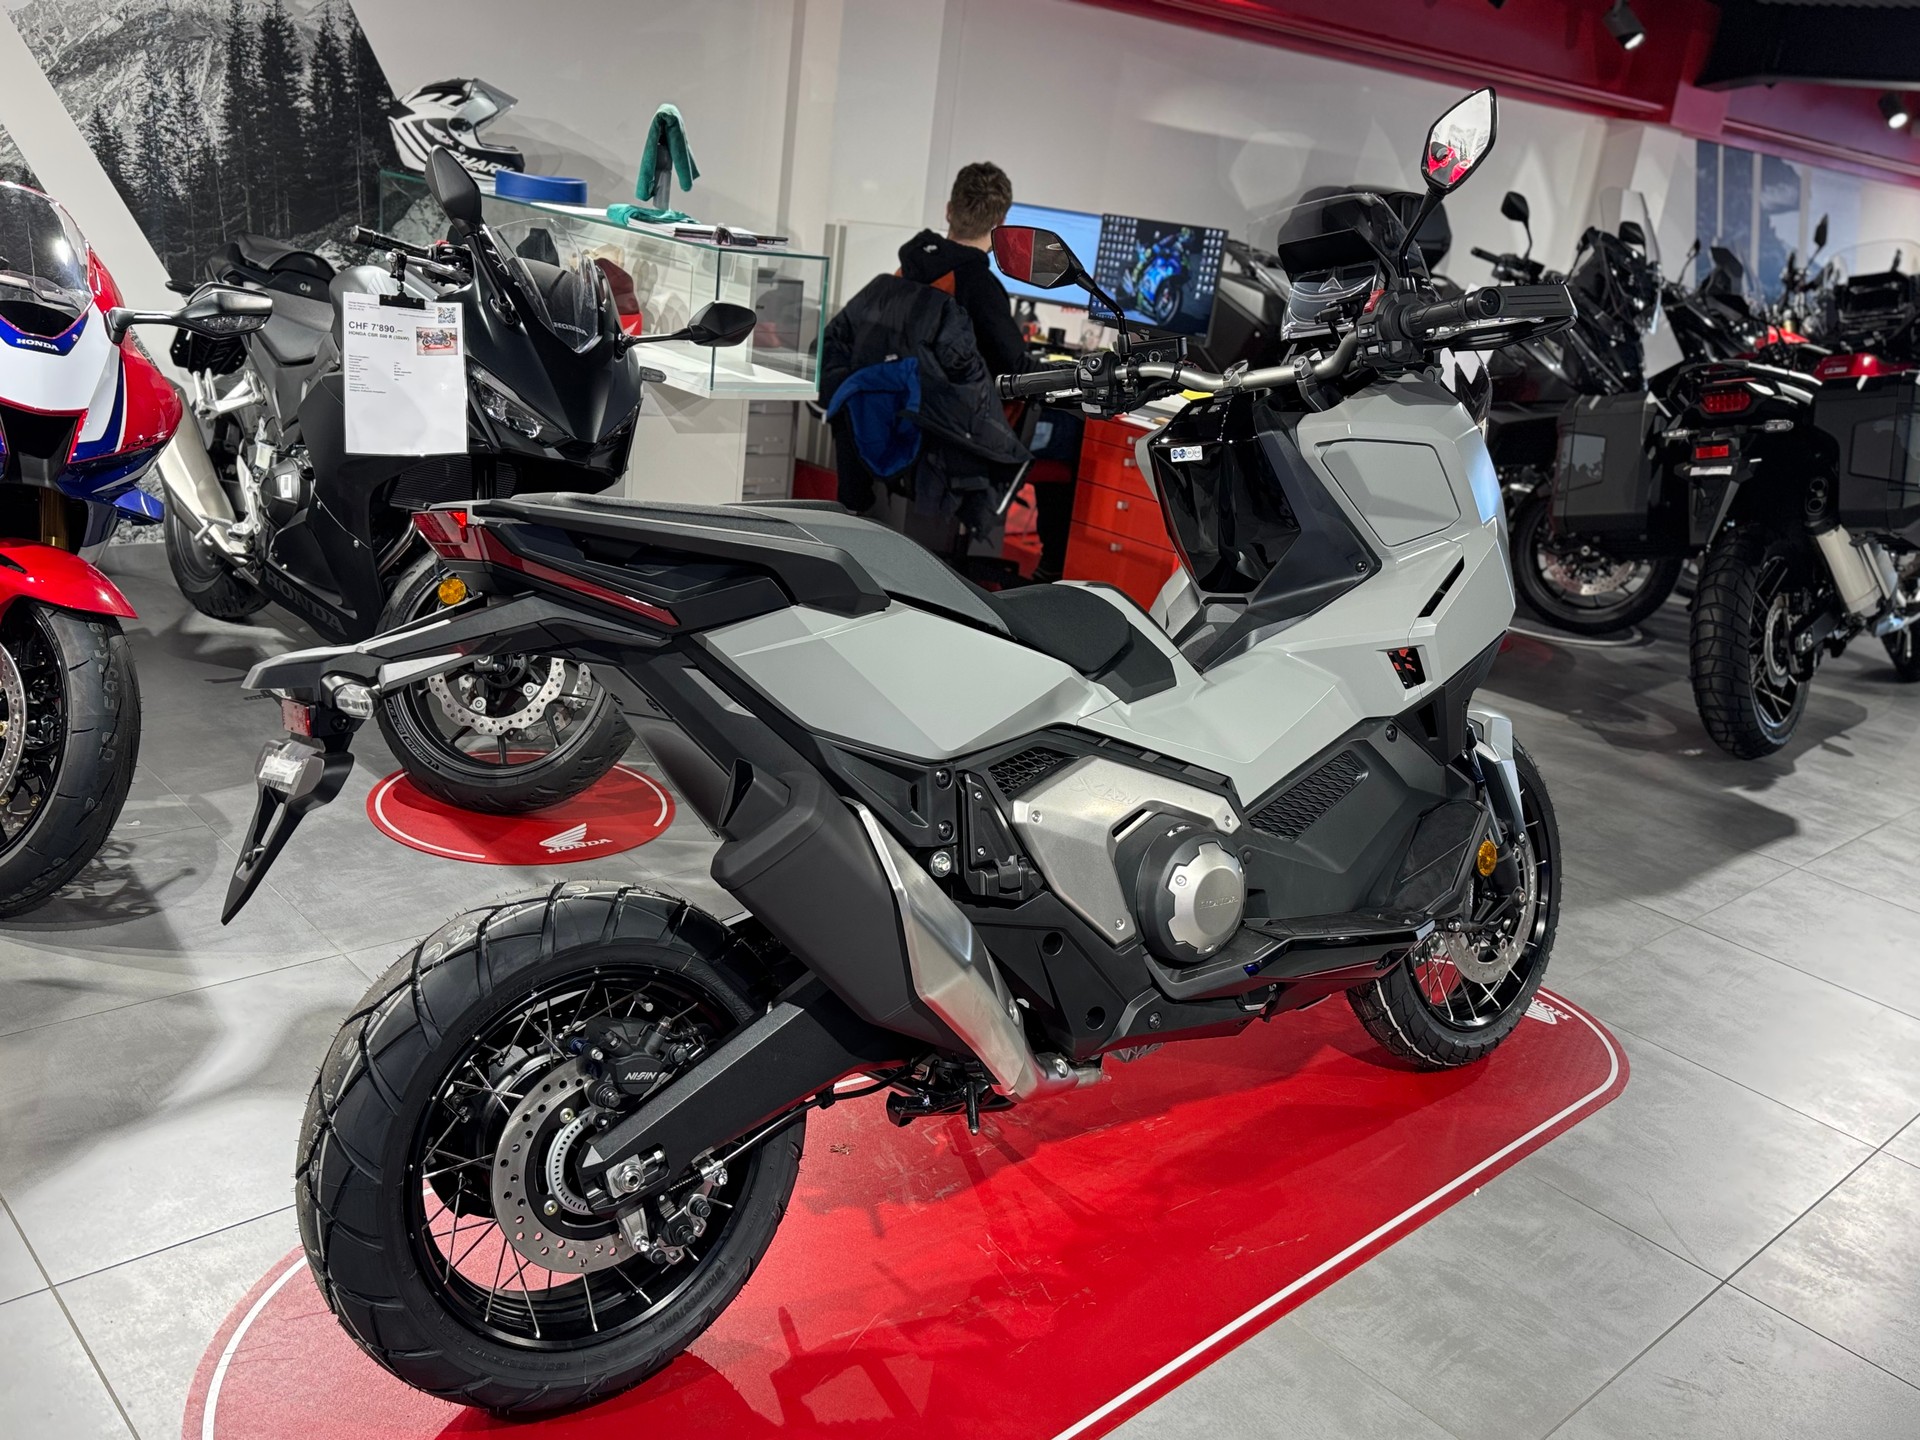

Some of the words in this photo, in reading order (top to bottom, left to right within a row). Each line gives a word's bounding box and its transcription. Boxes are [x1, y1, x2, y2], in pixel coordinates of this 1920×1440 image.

[348, 320, 369, 331] CHF
[553, 321, 589, 337] HONDA
[16, 338, 60, 351] HONDA
[263, 565, 348, 636] HONDA
[546, 838, 614, 854] HONDA
[1199, 895, 1239, 909] HONDA
[623, 1071, 658, 1081] NISSIN
